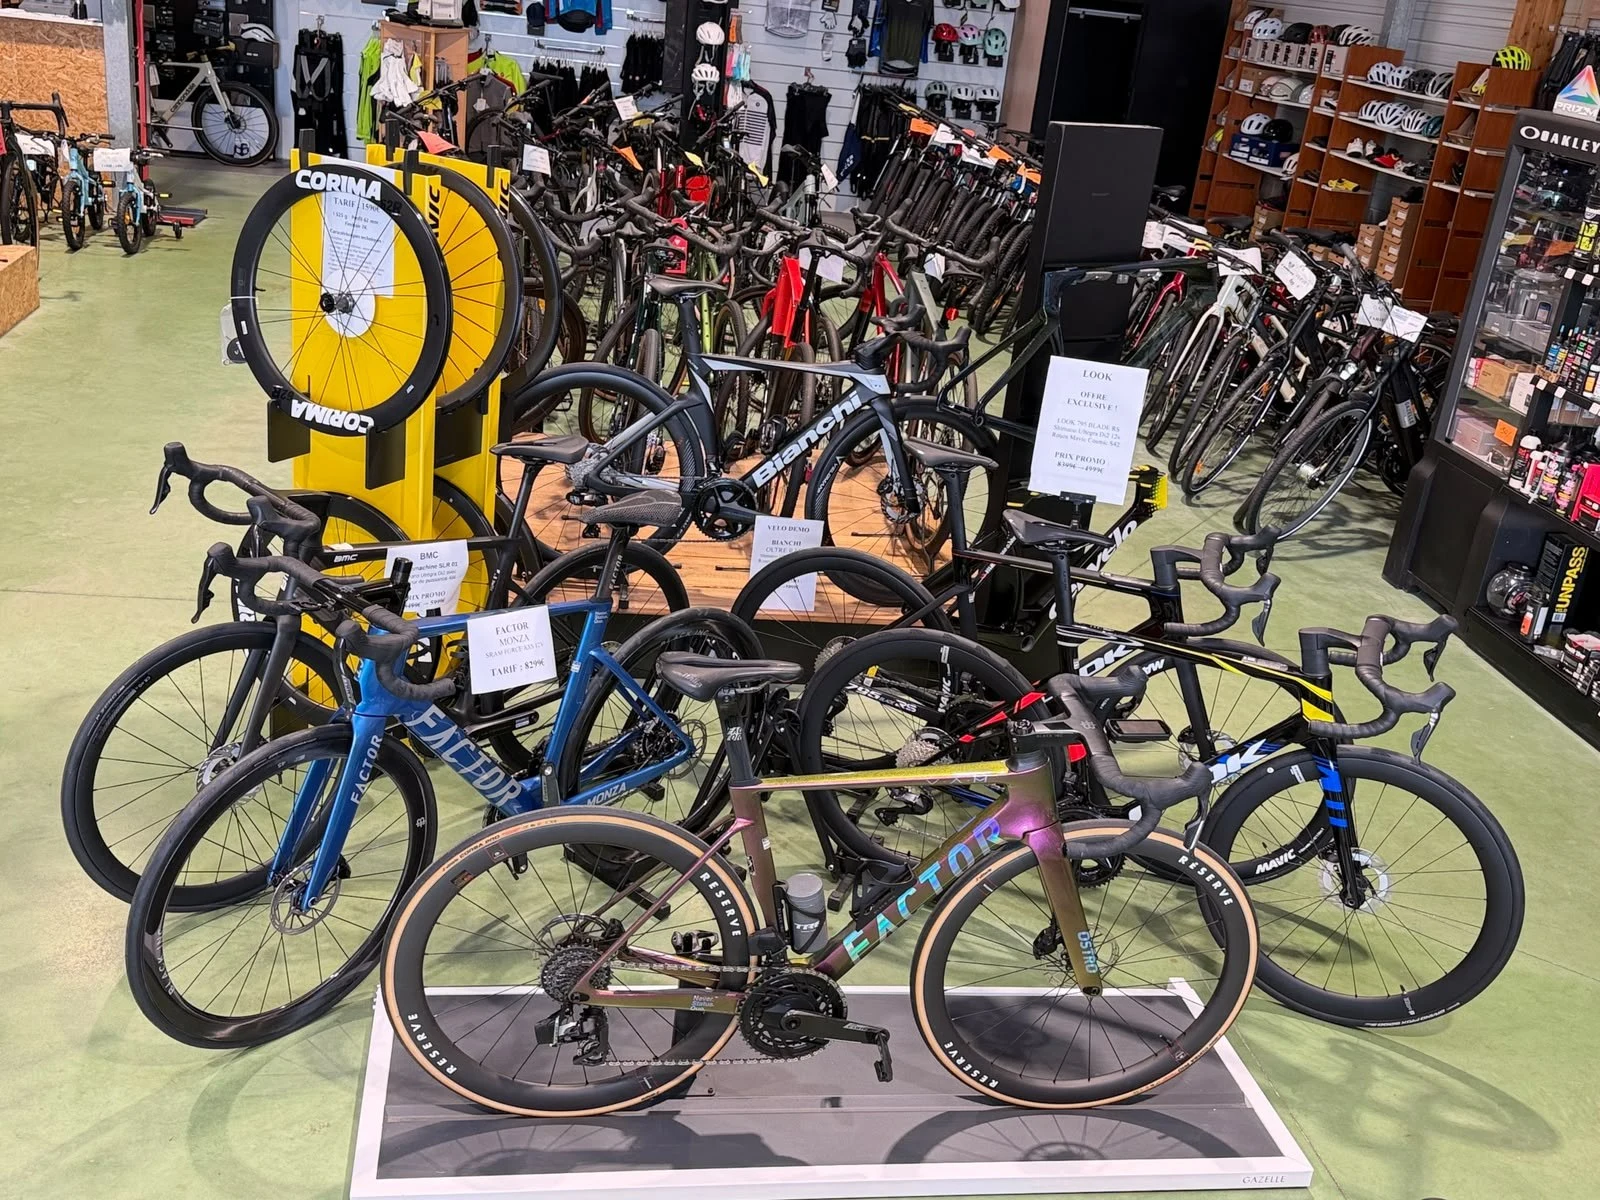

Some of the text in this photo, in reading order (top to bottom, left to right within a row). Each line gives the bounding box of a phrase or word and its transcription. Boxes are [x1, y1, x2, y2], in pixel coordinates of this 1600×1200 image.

[1554, 101, 1598, 117] PRIZM
[1540, 130, 1600, 154] OAKLEY
[295, 169, 382, 201] CORIMA
[334, 197, 356, 209] TARIF
[1083, 369, 1112, 381] LOOK
[1067, 398, 1114, 411] EXCLUSIVE
[1080, 391, 1107, 401] OFFRE
[290, 399, 374, 434] CORIMA
[1057, 418, 1075, 426] LOOK
[1088, 422, 1110, 431] BLADE
[751, 390, 862, 488] Bianchi
[1054, 451, 1106, 465] PRIX PROMO
[767, 524, 810, 533] VELO DEMO
[333, 554, 358, 563] BMC
[420, 551, 439, 560] BMC
[608, 555, 623, 590] FACTOR
[1556, 546, 1585, 609] UNPASS
[421, 590, 446, 599] PROMO
[495, 621, 529, 635] FACTOR
[499, 634, 530, 647] MONZA
[485, 650, 503, 658] SRAM
[504, 646, 522, 655] FORCE
[491, 664, 517, 677] TARIF
[845, 682, 881, 699] 795
[895, 699, 917, 713] RS
[404, 703, 522, 808] FACTOR
[350, 734, 383, 804] FACTOR
[586, 782, 627, 806] MONZA
[1255, 848, 1297, 875] MAVIC
[843, 818, 1007, 965] FACTOR
[700, 872, 742, 937] RESERVE
[1078, 931, 1098, 974] OSTRO
[408, 1013, 457, 1074] RESERVE
[944, 1041, 999, 1088] RESERVE
[1242, 1175, 1287, 1184] GAZELLE
